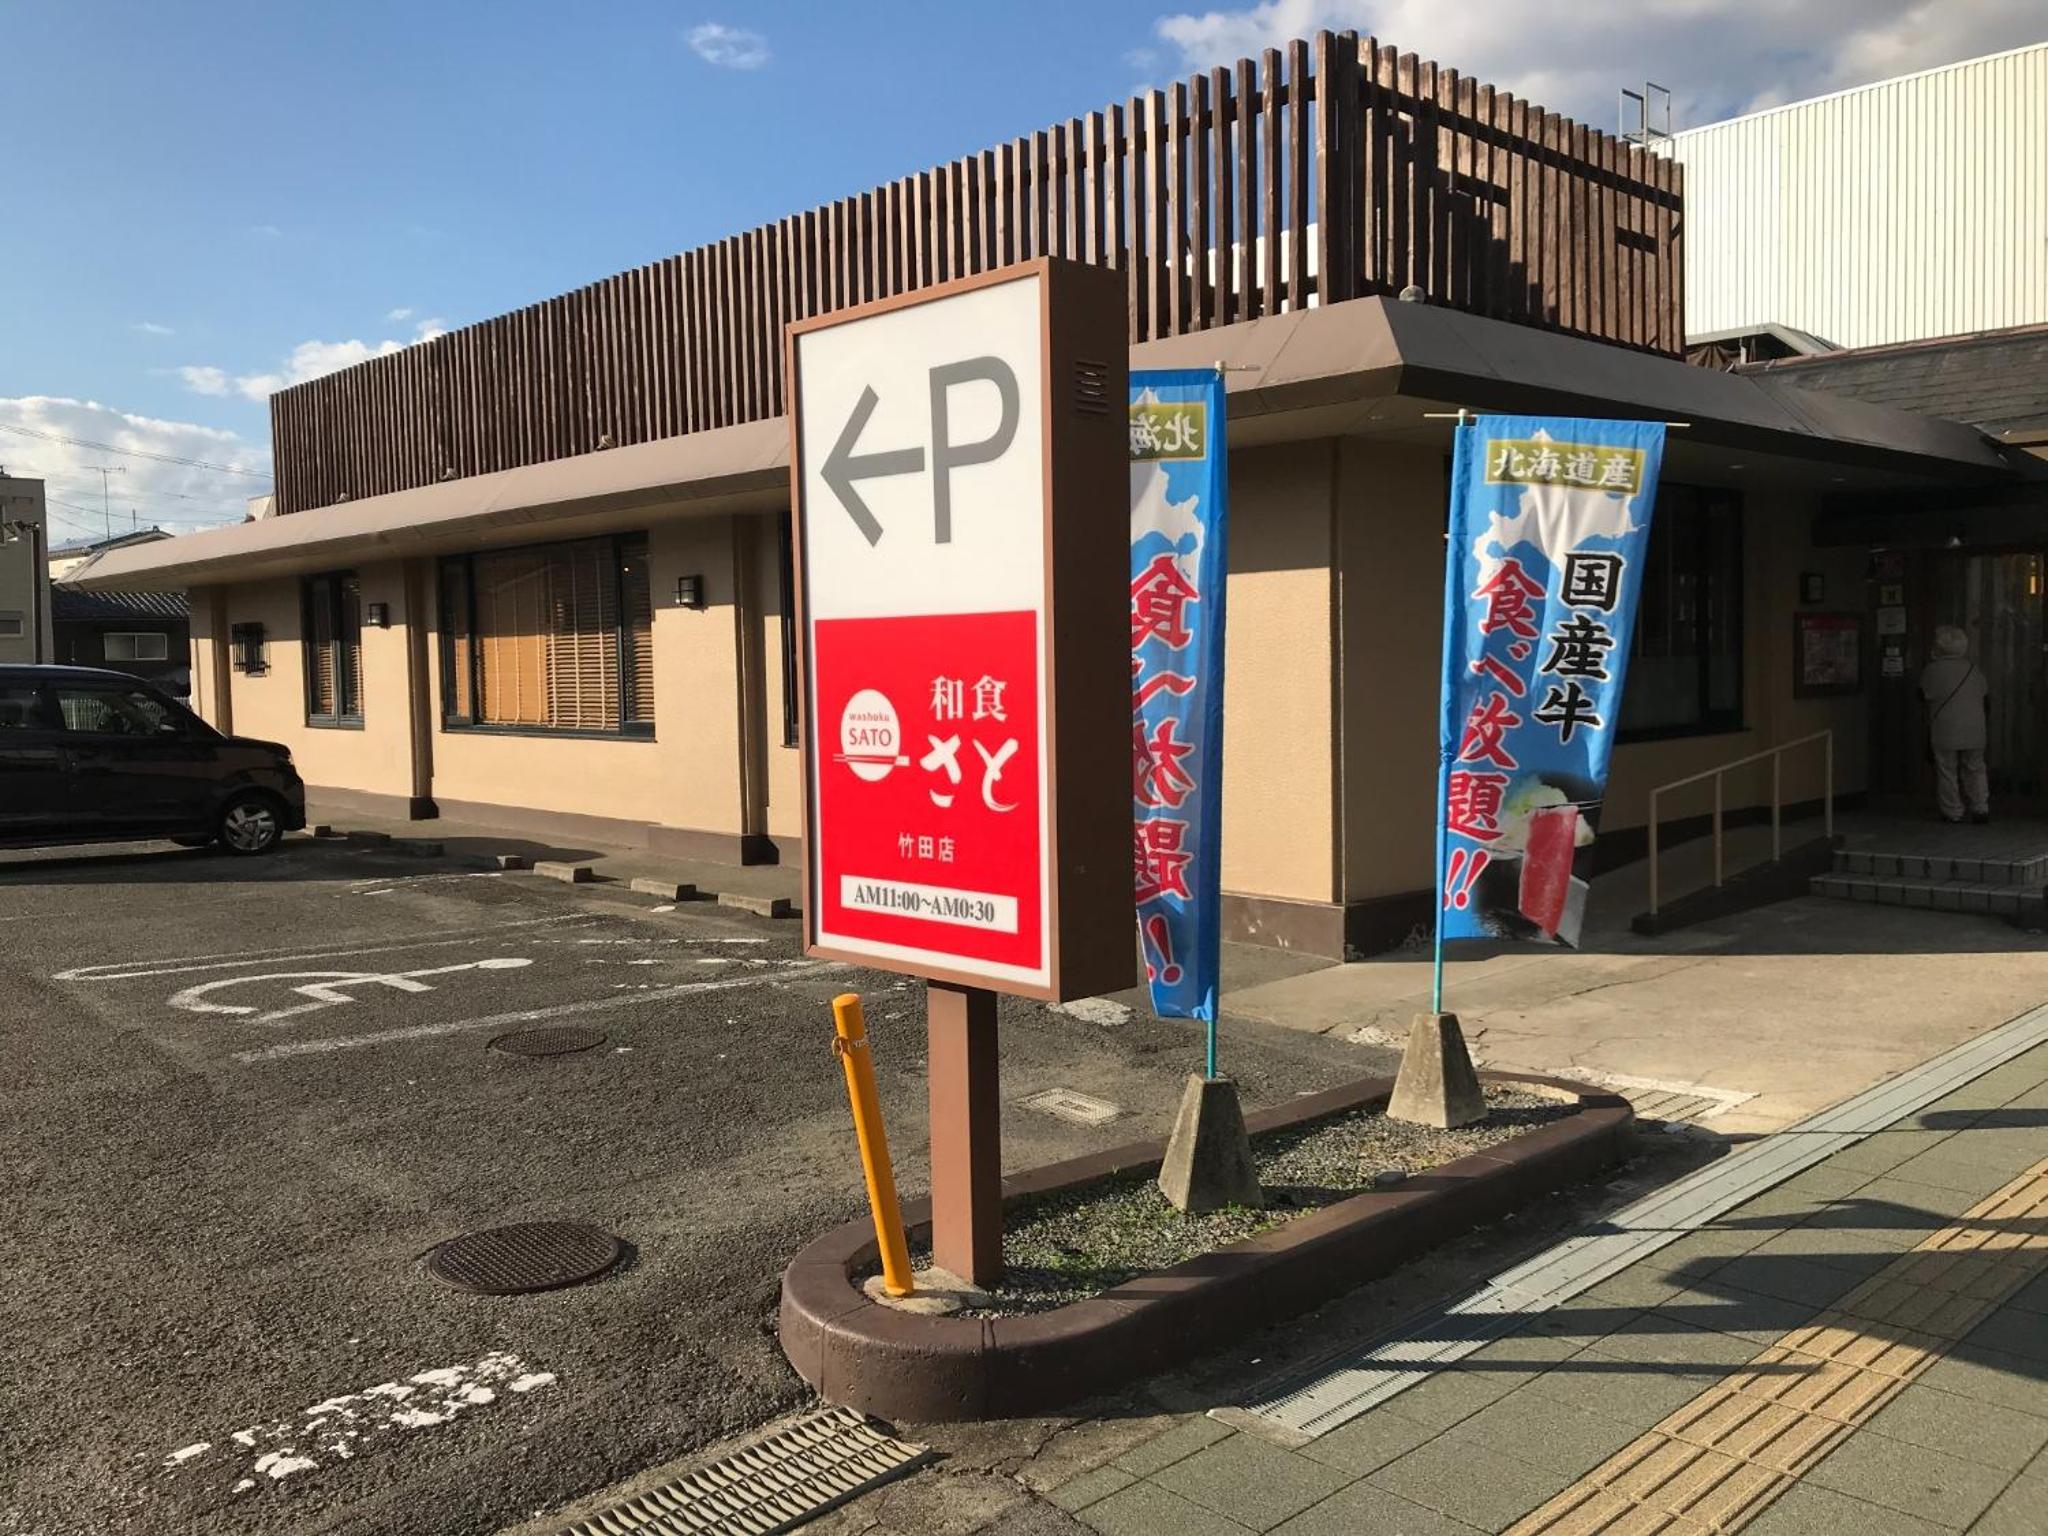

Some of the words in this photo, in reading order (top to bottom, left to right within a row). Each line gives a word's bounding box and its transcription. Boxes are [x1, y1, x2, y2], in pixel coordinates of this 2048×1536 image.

[928, 355, 1020, 545] P
[1492, 446, 1636, 489] 北海道産
[1534, 552, 1624, 743] 国産牛
[848, 711, 890, 722] washoku
[930, 674, 1008, 722] 和食
[848, 727, 892, 747] SATO
[919, 733, 1020, 813] さと
[898, 832, 955, 863] 竹田店
